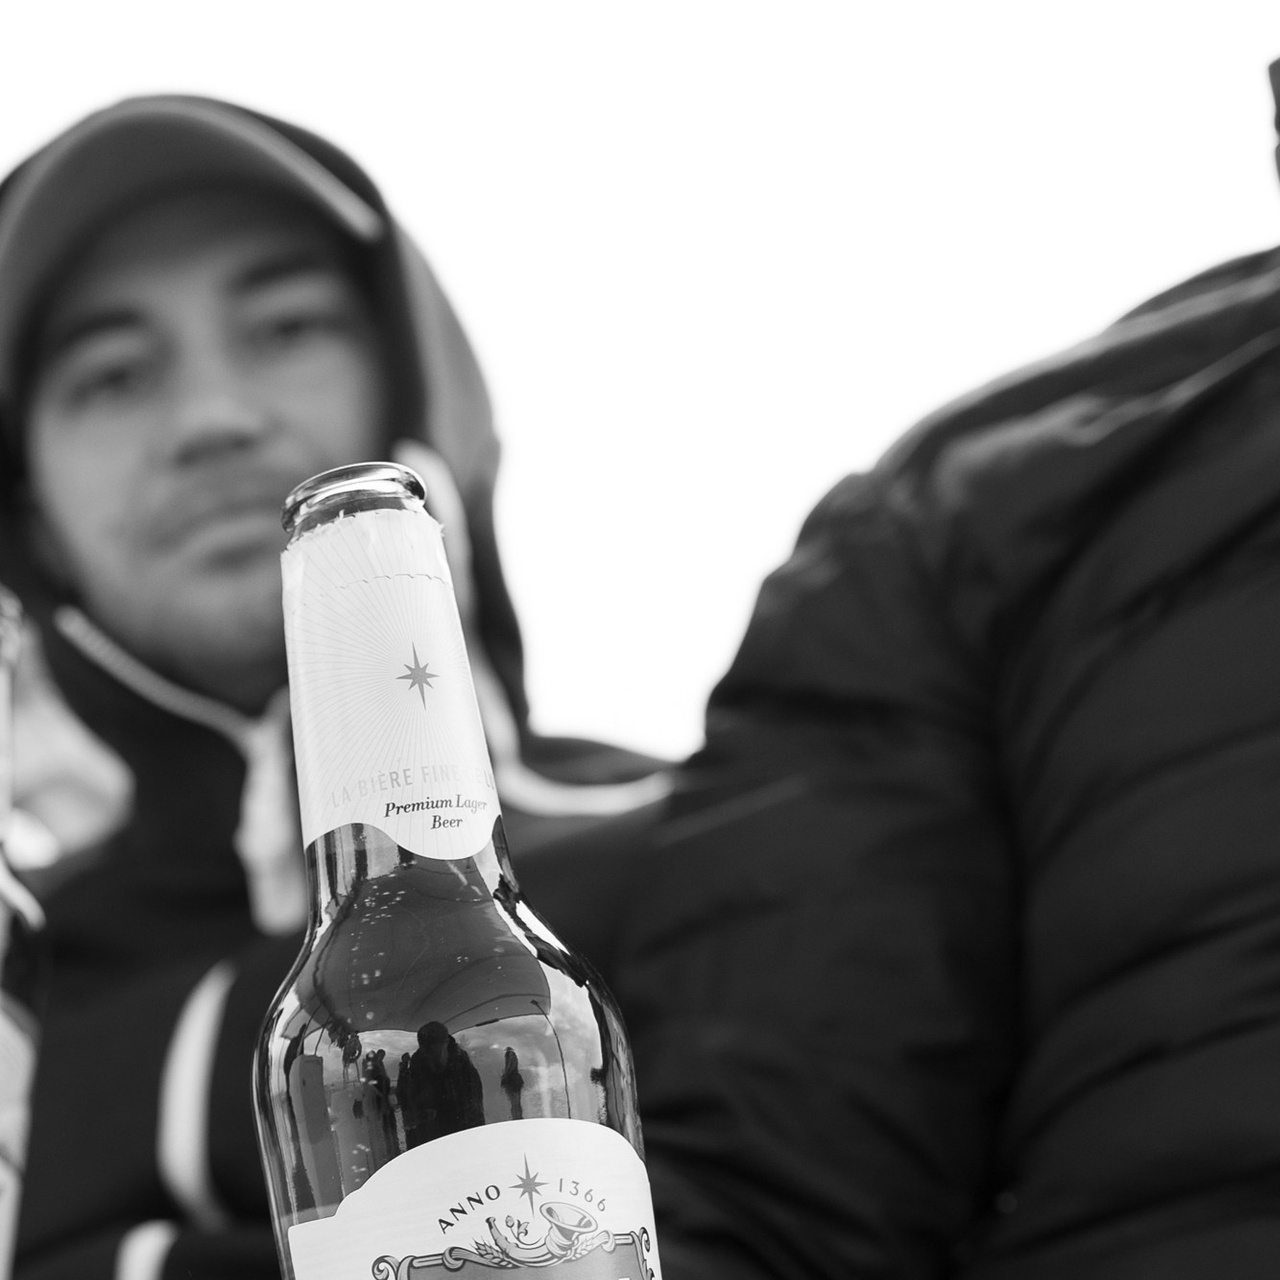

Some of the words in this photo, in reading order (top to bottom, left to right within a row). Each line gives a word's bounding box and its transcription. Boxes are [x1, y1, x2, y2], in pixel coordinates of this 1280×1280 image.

[383, 797, 453, 818] Premium
[456, 794, 488, 814] Lager
[430, 815, 464, 830] Beer
[437, 1184, 501, 1235] ANNO
[557, 1178, 607, 1213] 1366
